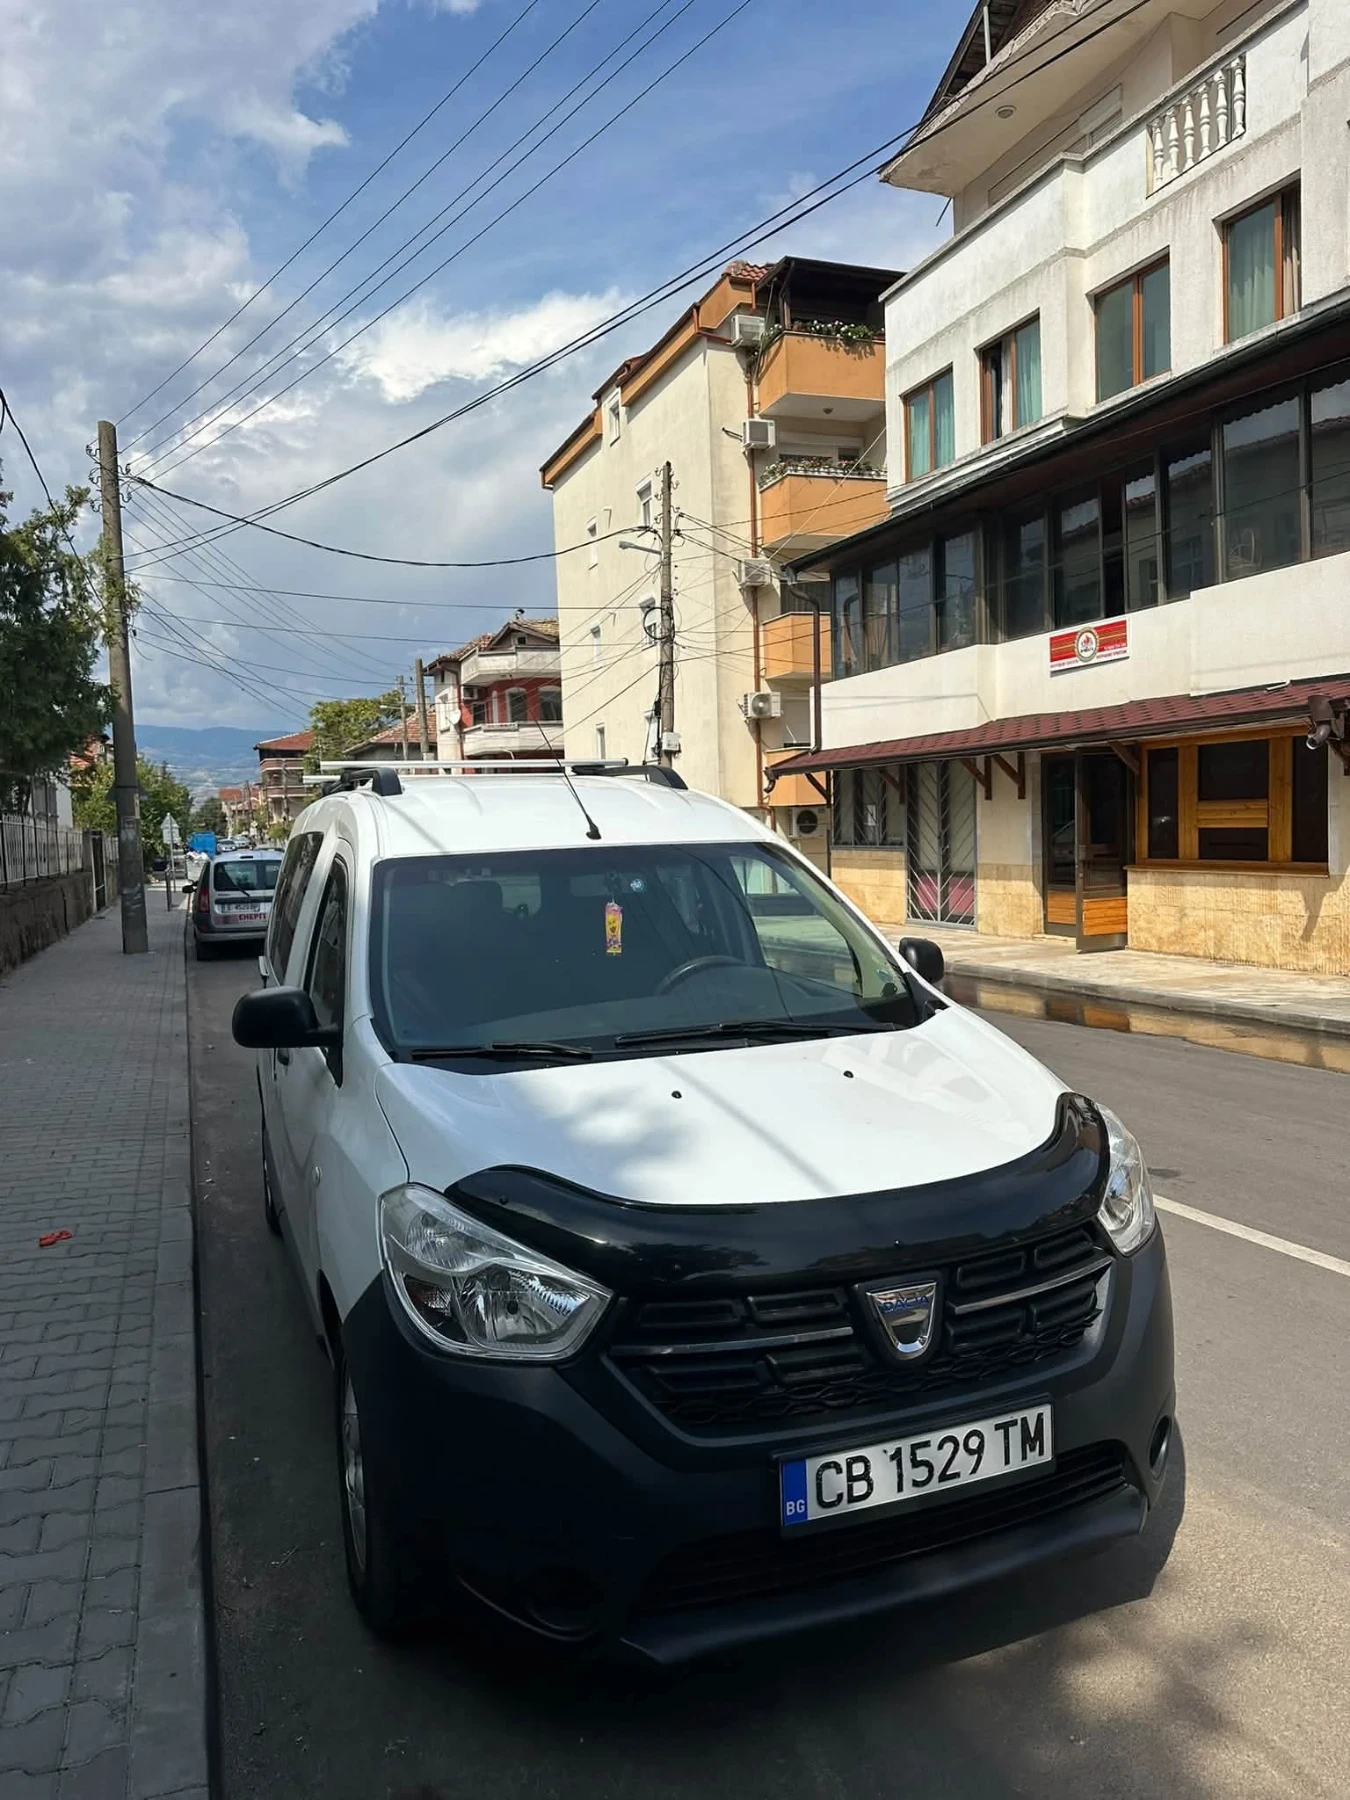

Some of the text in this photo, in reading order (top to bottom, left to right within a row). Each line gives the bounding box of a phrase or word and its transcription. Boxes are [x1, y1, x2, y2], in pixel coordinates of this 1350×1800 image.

[883, 1296, 929, 1311] DACIA
[815, 1412, 1044, 1510] CB 1529 TM
[786, 1499, 806, 1516] BG
